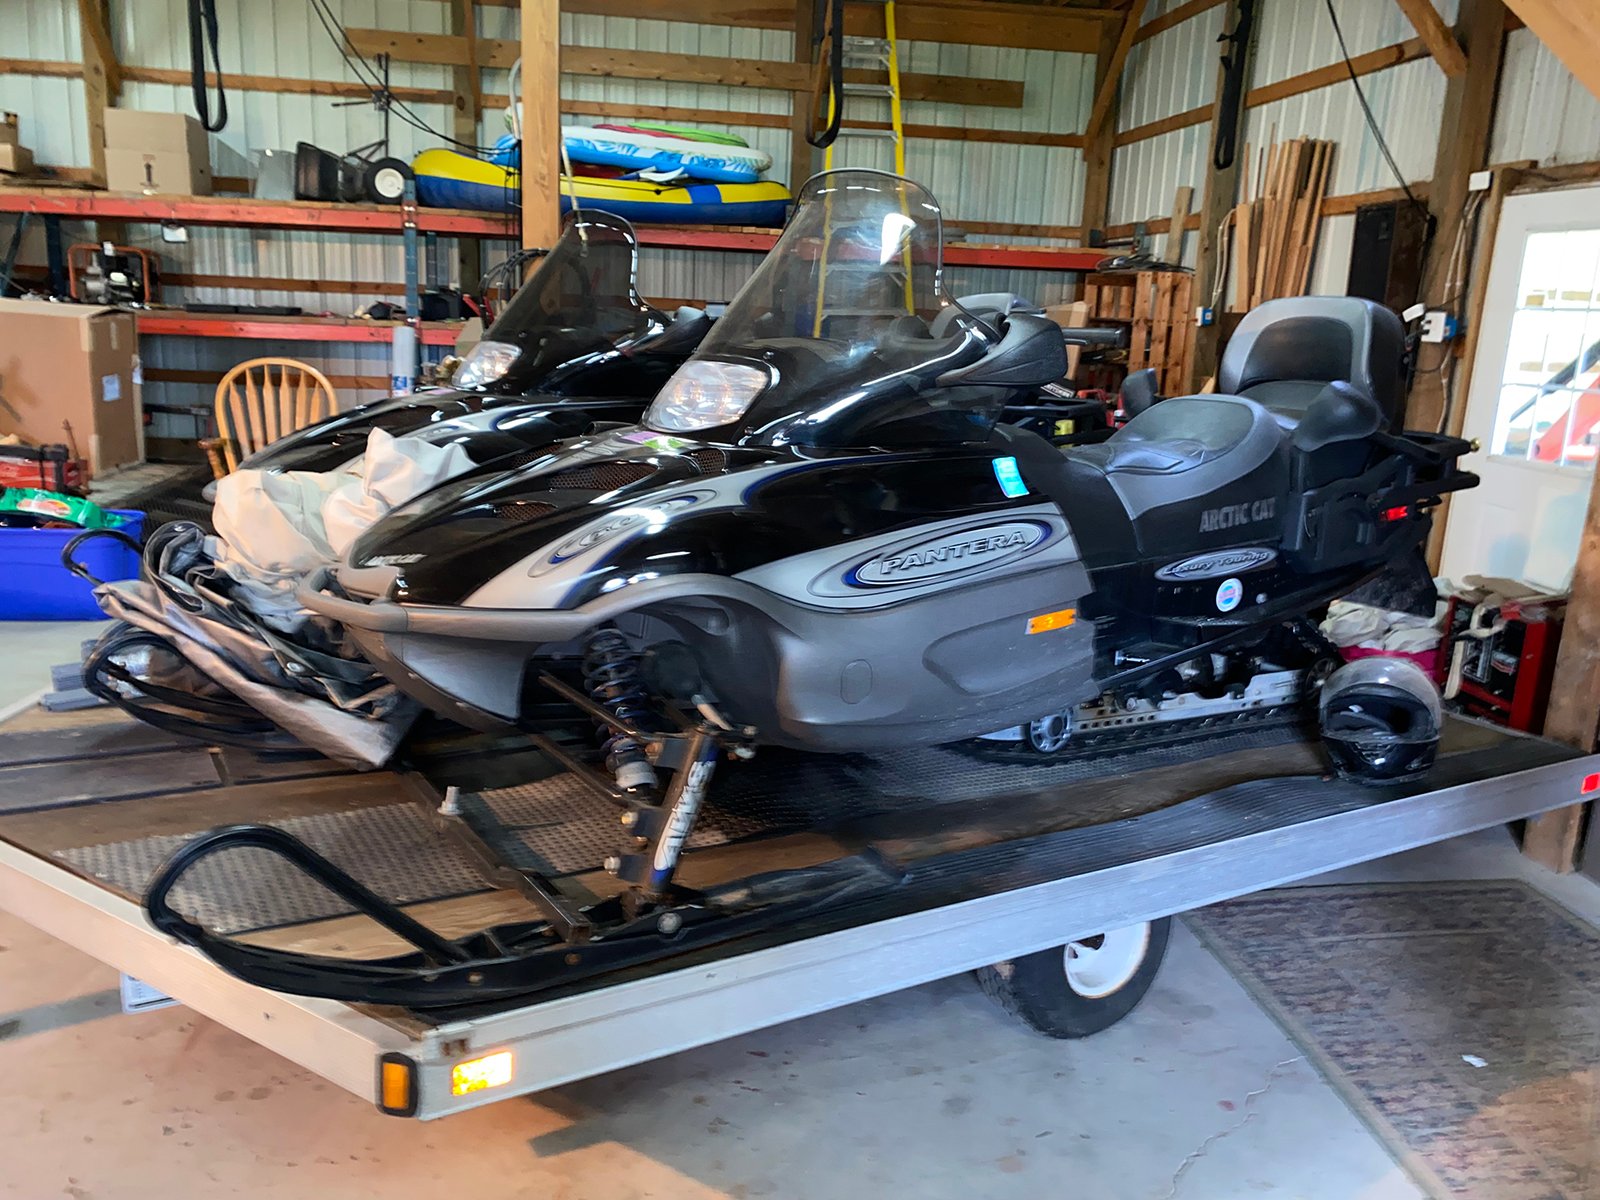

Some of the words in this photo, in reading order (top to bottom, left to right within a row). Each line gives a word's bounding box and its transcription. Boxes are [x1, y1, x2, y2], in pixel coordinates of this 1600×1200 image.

[1199, 502, 1250, 533] ARCTIC
[1251, 497, 1277, 521] CAT
[880, 530, 1026, 575] PANTERA
[1163, 560, 1215, 576] Luxury
[1219, 551, 1270, 567] Touring
